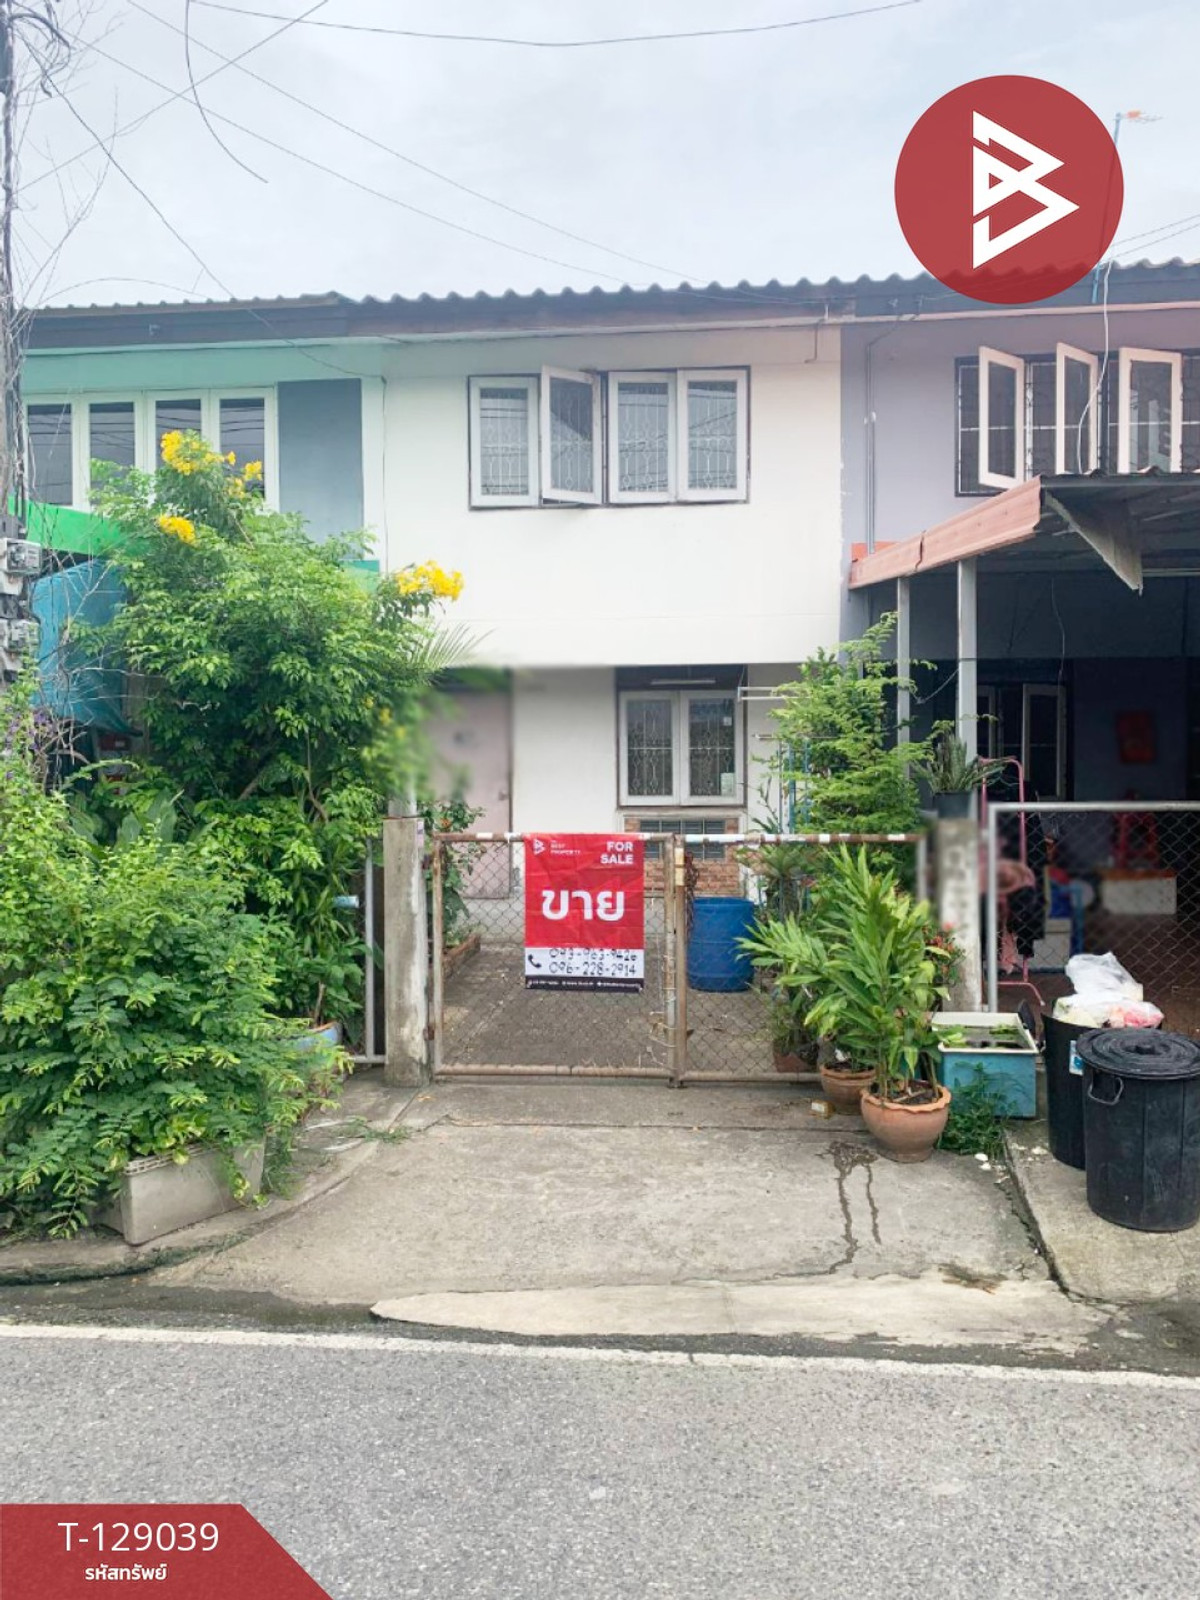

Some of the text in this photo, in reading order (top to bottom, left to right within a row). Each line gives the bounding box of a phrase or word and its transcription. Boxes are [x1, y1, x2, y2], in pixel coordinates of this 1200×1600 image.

[606, 841, 634, 852] FOR
[600, 854, 634, 865] SALE
[541, 889, 625, 922] ขาย
